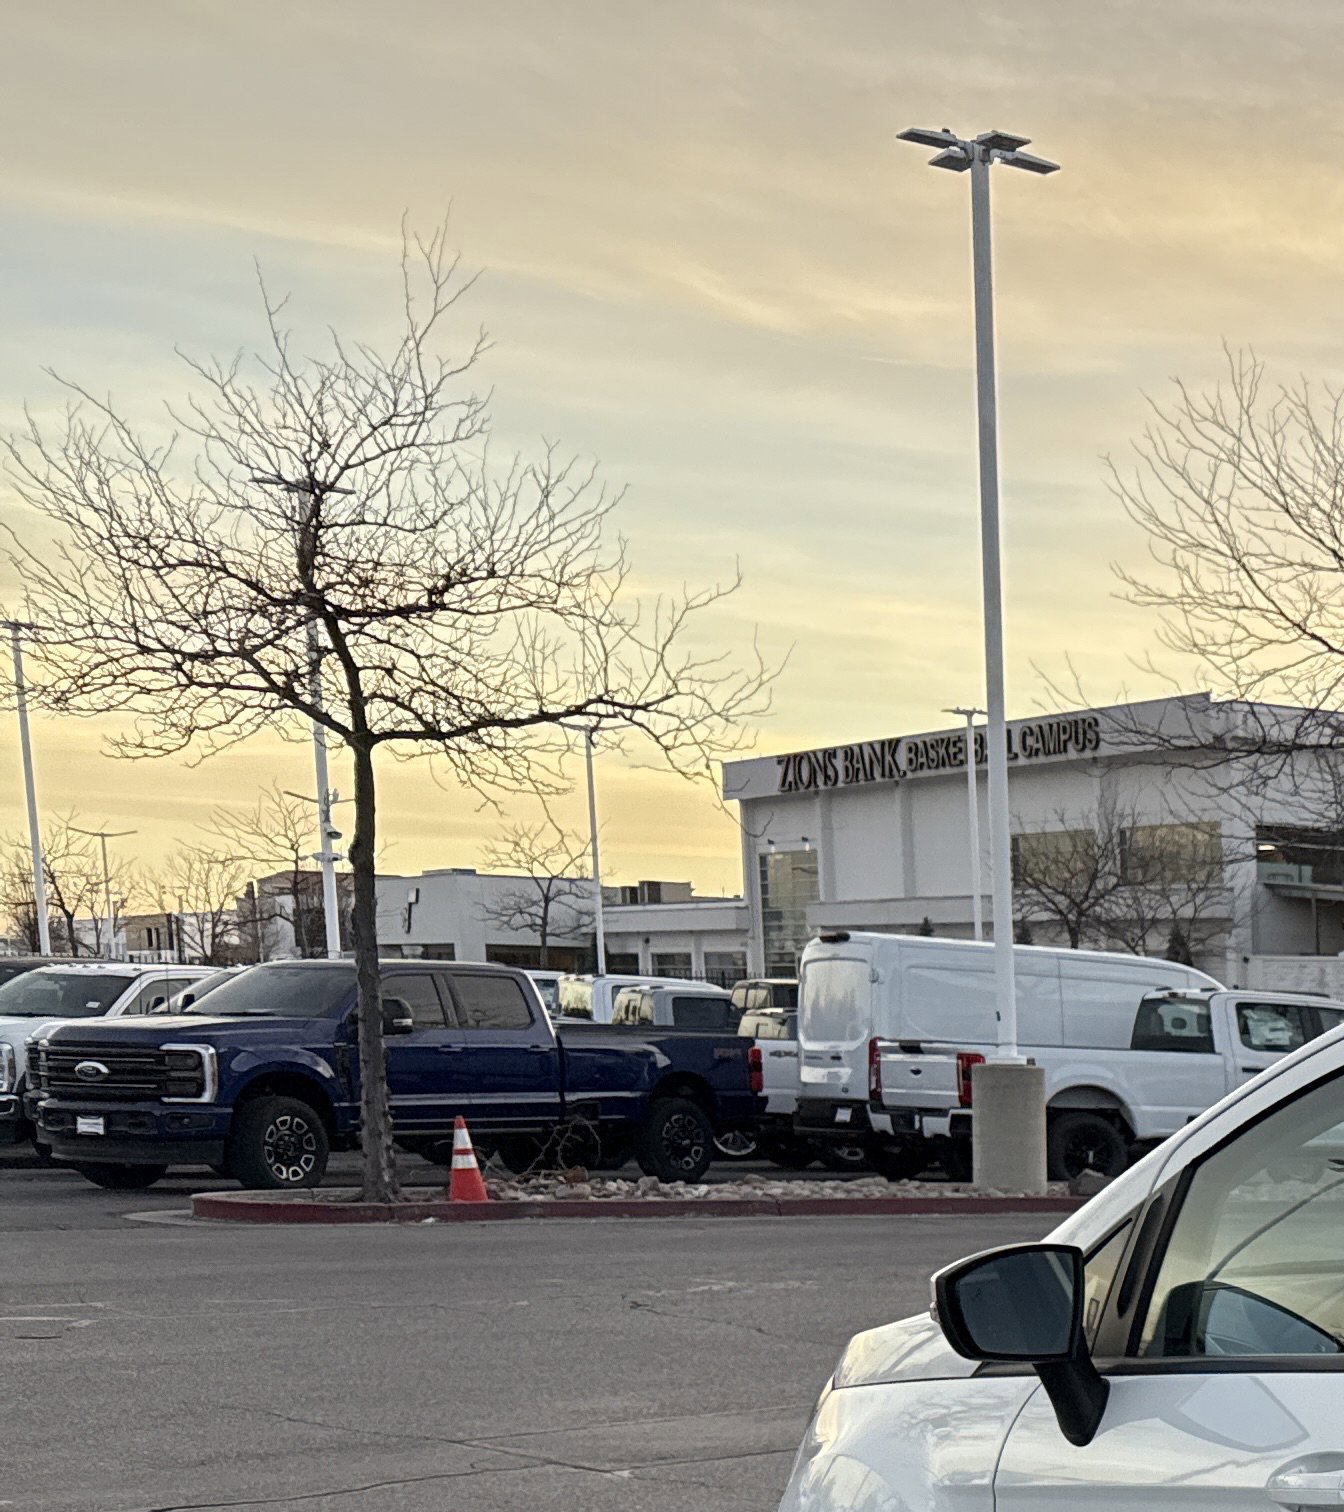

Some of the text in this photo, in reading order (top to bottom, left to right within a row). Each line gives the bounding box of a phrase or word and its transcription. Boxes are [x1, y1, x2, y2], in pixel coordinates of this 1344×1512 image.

[776, 748, 839, 793] ZIONS
[906, 728, 1019, 772] BASKEBL
[1019, 716, 1101, 759] CAMPUS
